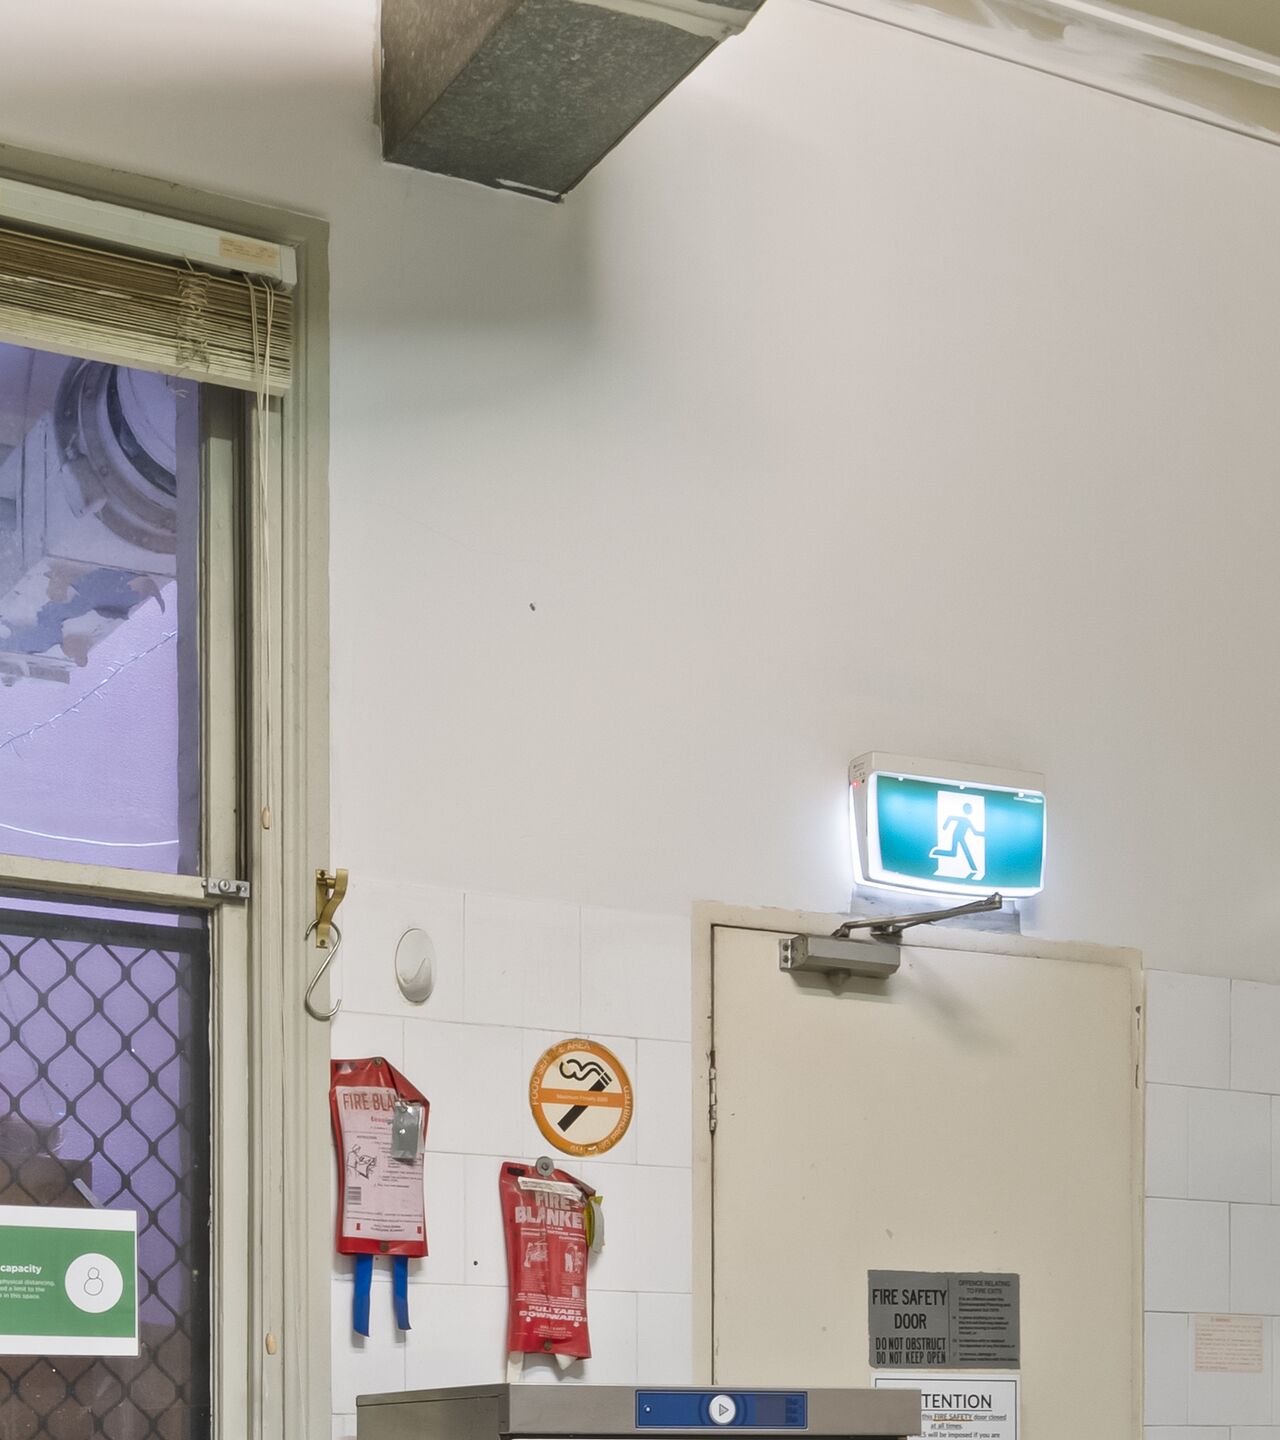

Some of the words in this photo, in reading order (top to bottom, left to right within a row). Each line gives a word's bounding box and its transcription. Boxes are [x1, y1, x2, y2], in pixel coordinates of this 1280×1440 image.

[343, 1094, 369, 1110] FIRE
[535, 1191, 570, 1210] FIRE
[0, 1264, 42, 1275] capacity
[872, 1289, 898, 1305] FIRE
[902, 1289, 947, 1305] SAFETY
[894, 1313, 926, 1329] DOOR
[876, 1337, 886, 1350] DO
[889, 1337, 903, 1350] NOT
[906, 1337, 946, 1350] OBSTRUCT
[876, 1351, 886, 1364] DO
[889, 1351, 902, 1364] NOT
[906, 1351, 924, 1364] KEEP
[927, 1351, 946, 1364] OPEN
[921, 1394, 992, 1408] TENTION
